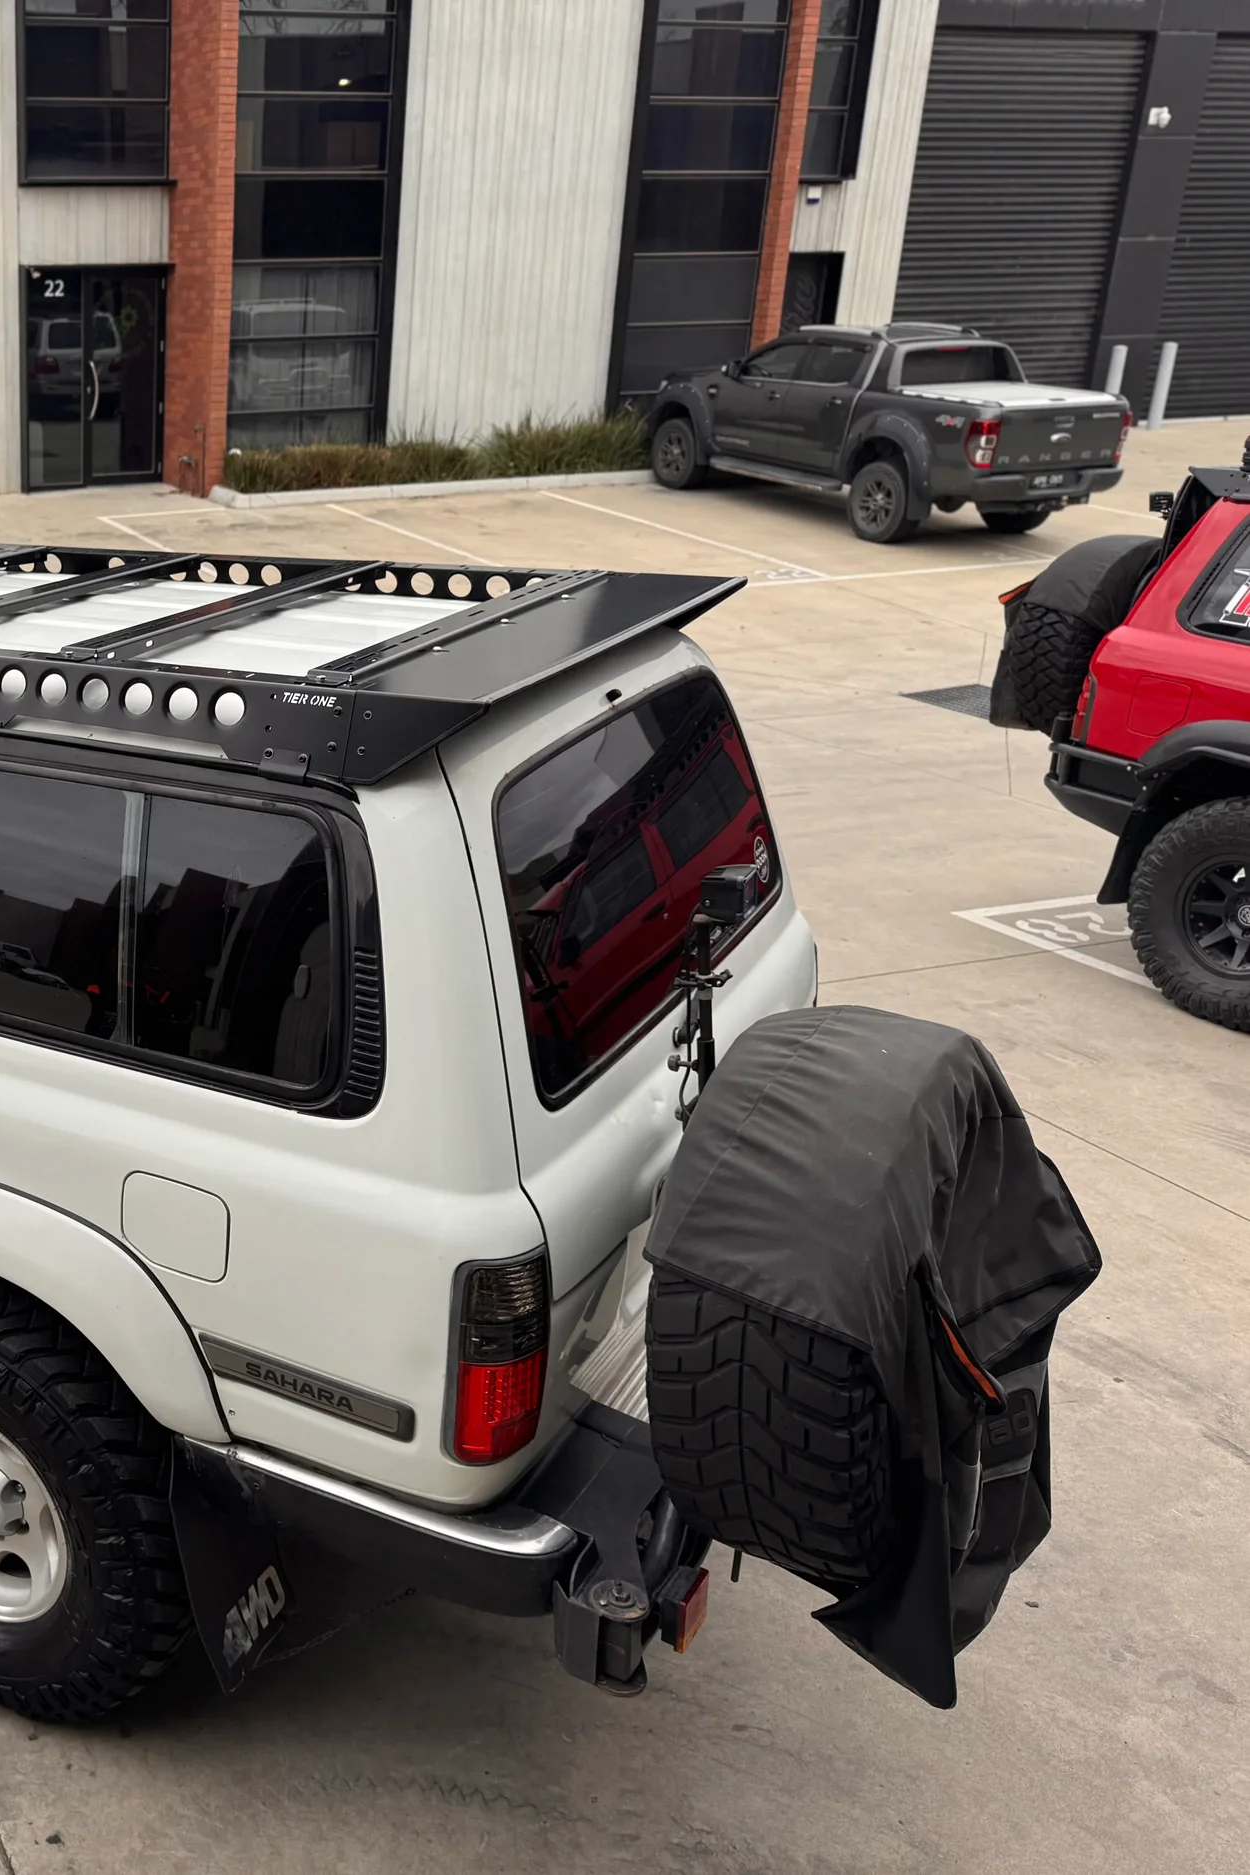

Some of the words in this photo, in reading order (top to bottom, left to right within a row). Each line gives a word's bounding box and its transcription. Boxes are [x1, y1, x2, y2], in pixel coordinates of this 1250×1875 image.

[43, 279, 65, 298] 22
[998, 449, 1112, 465] RANGER
[282, 692, 309, 705] TIER
[309, 695, 337, 708] ONE
[245, 1362, 354, 1413] SAHARA
